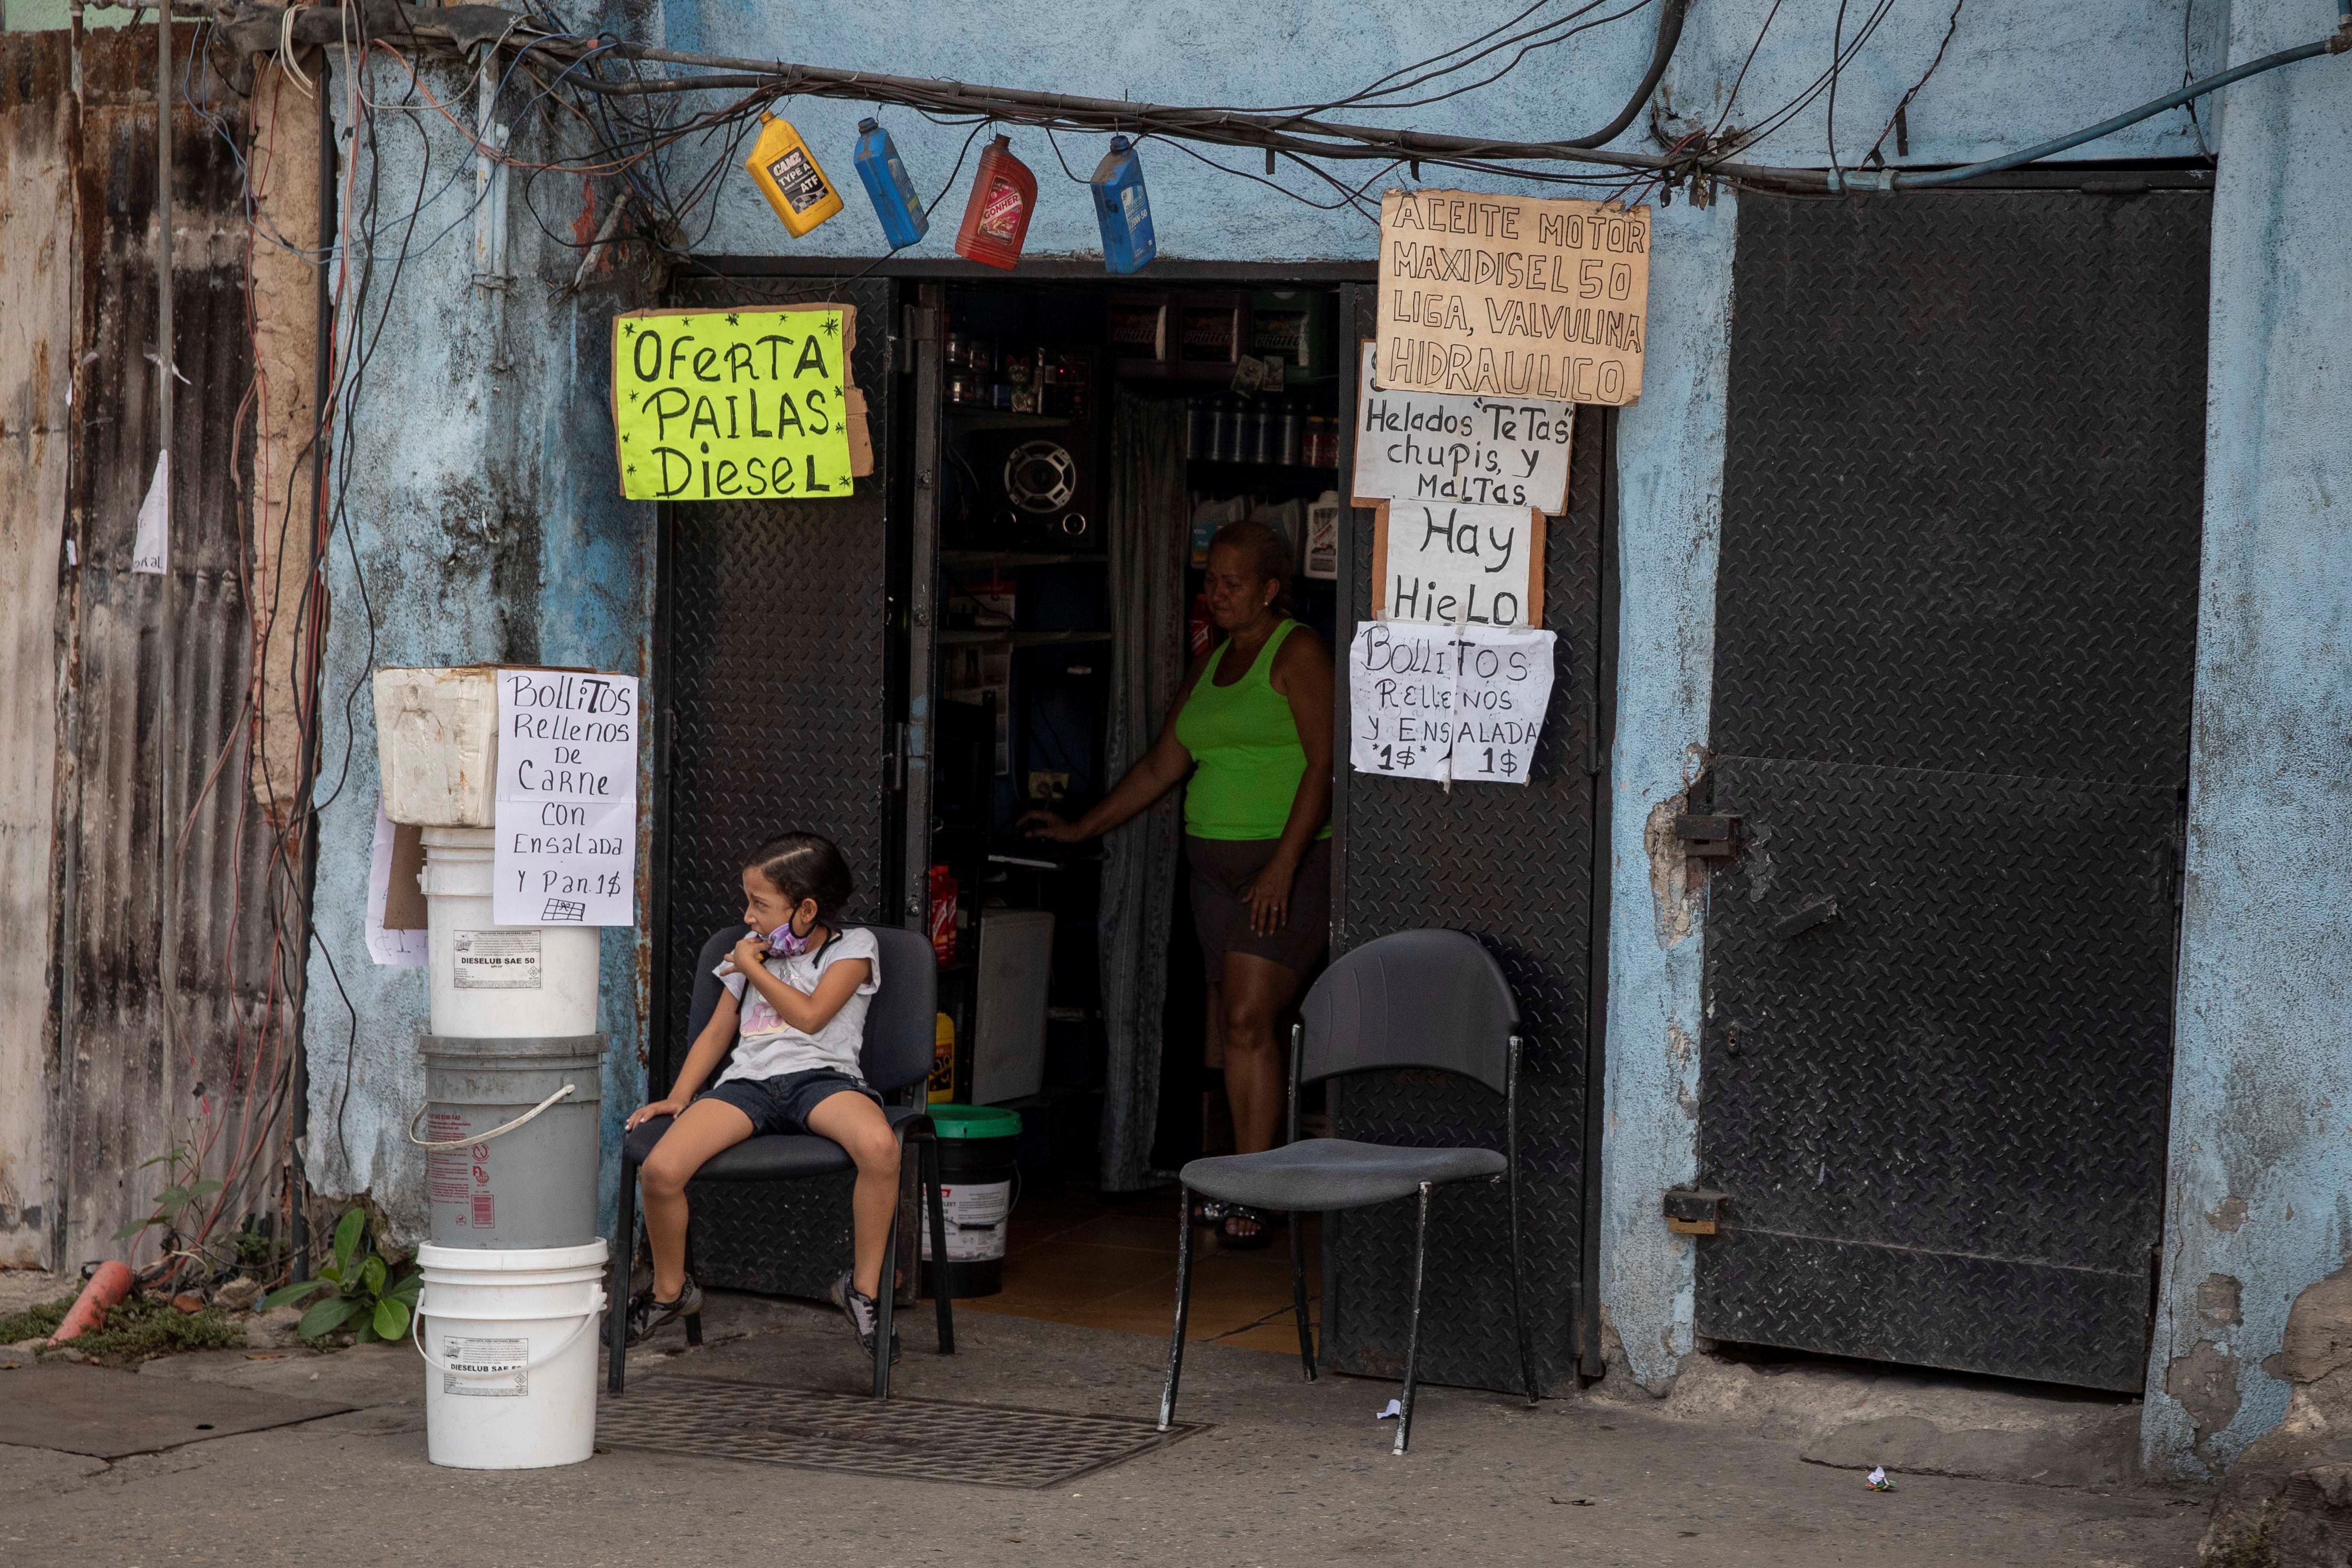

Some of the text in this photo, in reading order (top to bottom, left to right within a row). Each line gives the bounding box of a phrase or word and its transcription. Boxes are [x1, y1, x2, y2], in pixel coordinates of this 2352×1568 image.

[773, 151, 802, 177] CAM2
[778, 167, 803, 186] TYPE
[803, 162, 811, 172] A
[800, 175, 818, 193] ATF
[984, 194, 1018, 219] GONHER
[1392, 195, 1646, 253] ACEITE MOTOR
[1579, 259, 1632, 301] 50
[1393, 290, 1642, 354] LIGA, VALVULINA
[1388, 337, 1625, 404] HIDRAULICO
[642, 387, 829, 441] PAILAS
[1365, 398, 1473, 437] Helados
[1419, 506, 1515, 573] Hay
[1398, 717, 1537, 745] ENSALADA
[518, 869, 526, 892] Y
[451, 1363, 489, 1372] DIESELUB
